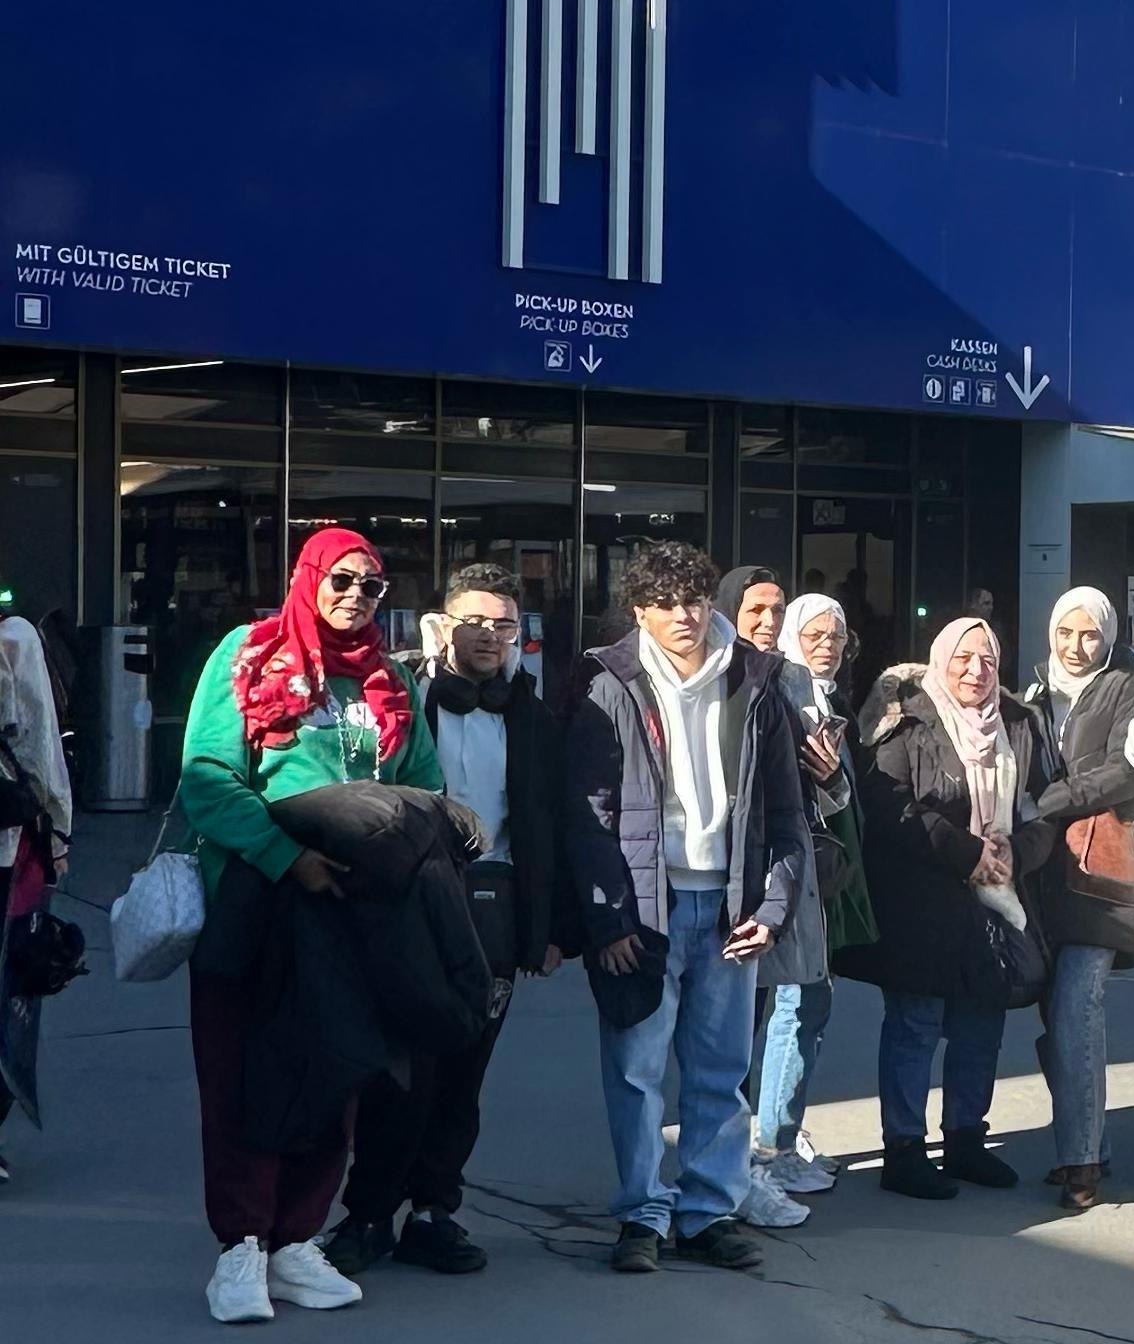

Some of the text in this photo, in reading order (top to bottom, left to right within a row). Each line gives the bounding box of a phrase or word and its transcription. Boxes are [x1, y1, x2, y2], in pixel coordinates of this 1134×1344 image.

[16, 243, 231, 279] MIT GÜLTIGEM TICKET
[17, 266, 193, 298] WITH VALID TICKET
[515, 293, 633, 319] PICK-UP BOXEN
